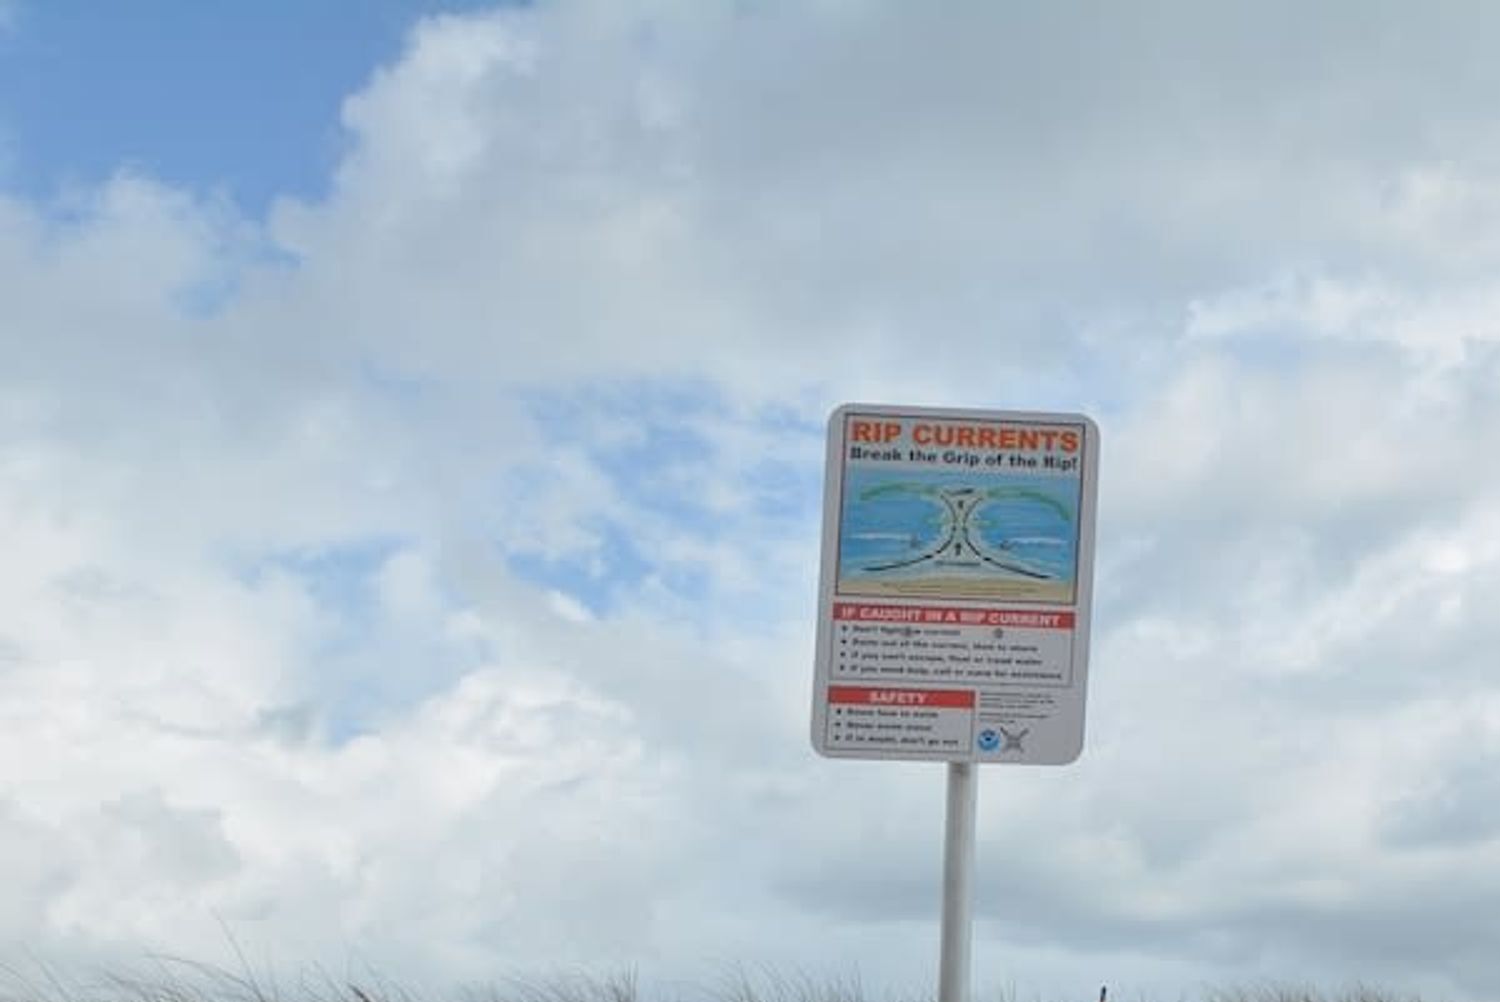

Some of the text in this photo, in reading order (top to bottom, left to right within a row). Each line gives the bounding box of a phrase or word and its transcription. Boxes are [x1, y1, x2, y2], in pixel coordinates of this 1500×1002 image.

[853, 422, 1079, 453] RIP CURRENTS
[850, 445, 1079, 472] Break the Grip of the Rip!
[841, 605, 857, 620] IF
[860, 606, 920, 622] CAUGHT
[944, 609, 958, 622] A
[987, 611, 1061, 629] CURRENT
[869, 690, 928, 704] SAFETY
